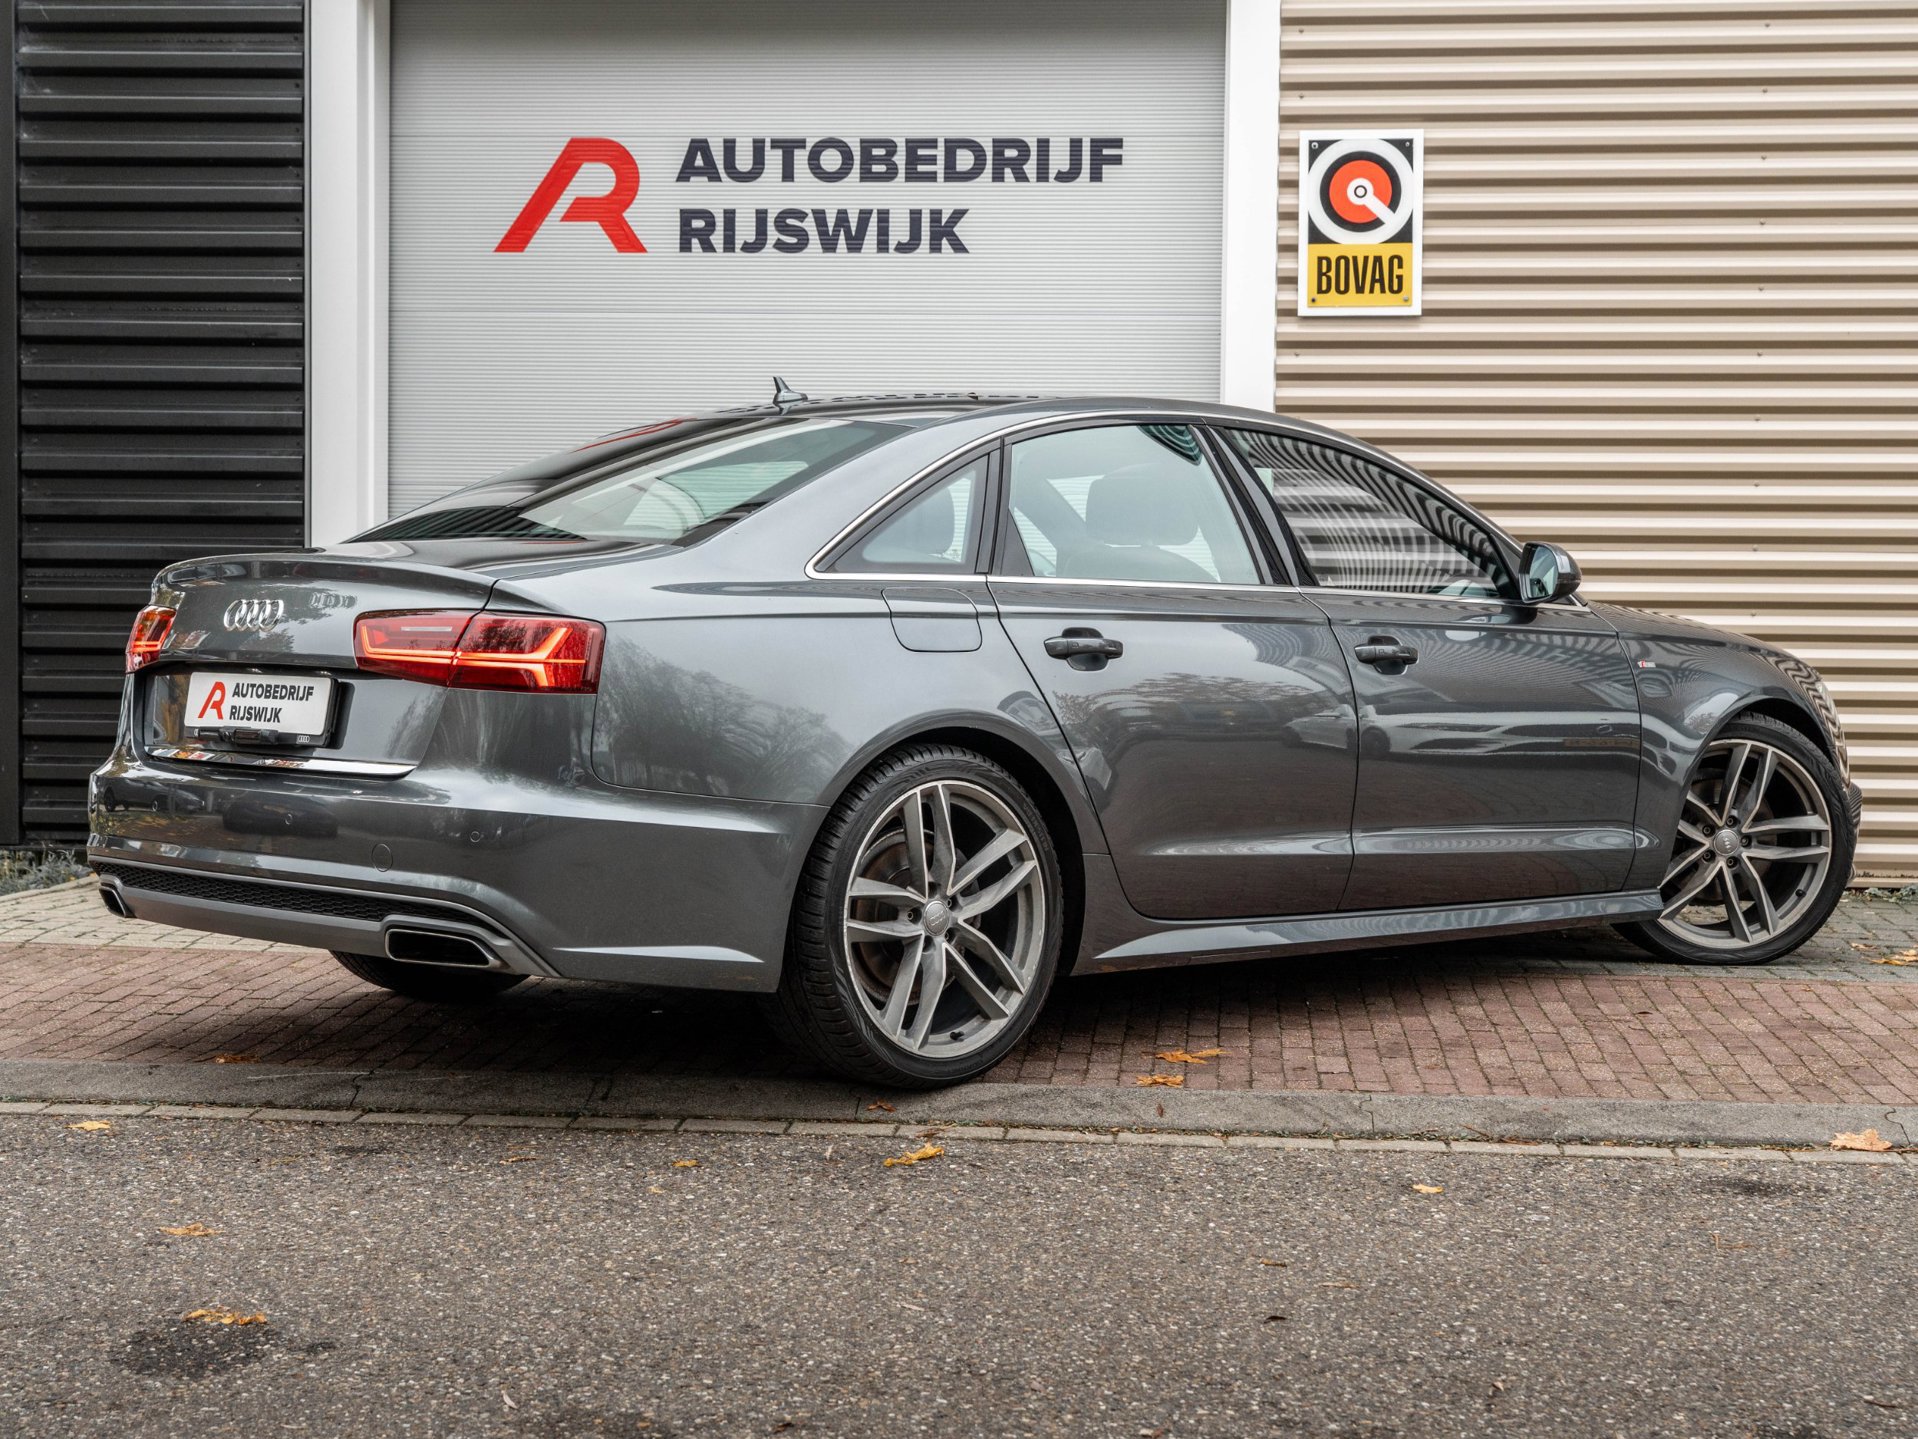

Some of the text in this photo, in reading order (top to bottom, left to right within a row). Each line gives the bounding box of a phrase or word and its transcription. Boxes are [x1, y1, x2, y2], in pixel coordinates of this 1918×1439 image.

[675, 138, 1124, 183] AUTOBEDRIJF
[680, 209, 970, 253] RIJSWIJK
[1316, 254, 1404, 295] BOVAG
[232, 683, 315, 701] AUTOBEDRIJF
[229, 705, 283, 723] RIJSWIJK
